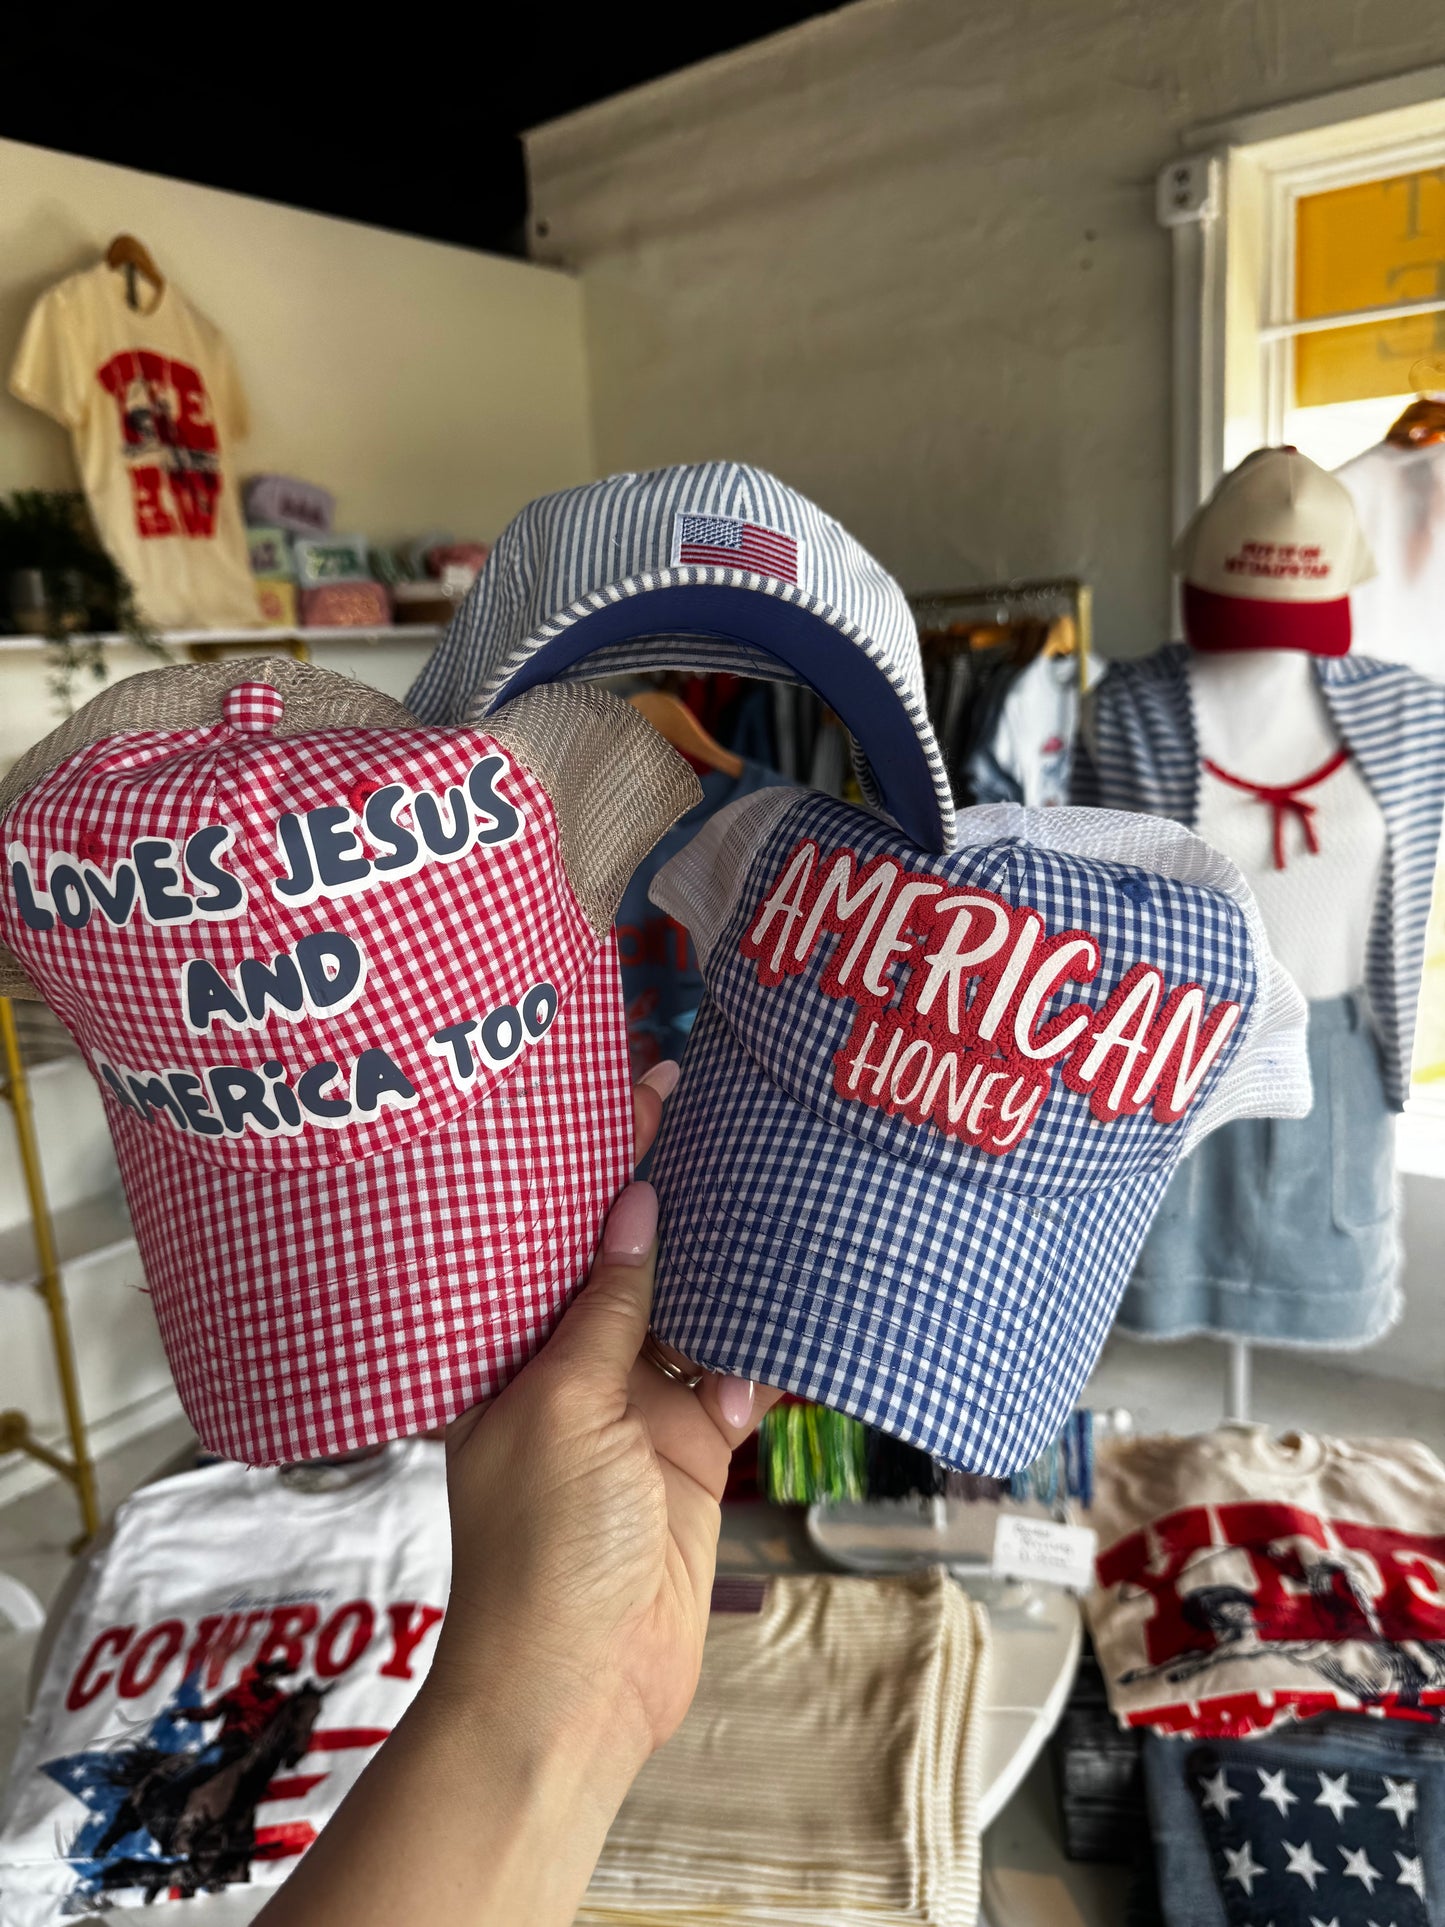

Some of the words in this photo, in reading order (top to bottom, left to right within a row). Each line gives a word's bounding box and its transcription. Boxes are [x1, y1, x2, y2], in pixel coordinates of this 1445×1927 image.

[11, 825, 243, 931] LOVES
[274, 754, 522, 897] JESUS
[185, 931, 362, 1029] AND
[433, 982, 559, 1082] TOO
[751, 842, 1241, 1113] AMERICAN
[846, 1019, 1043, 1147] HONEY
[65, 1597, 445, 1713] COWBOY
